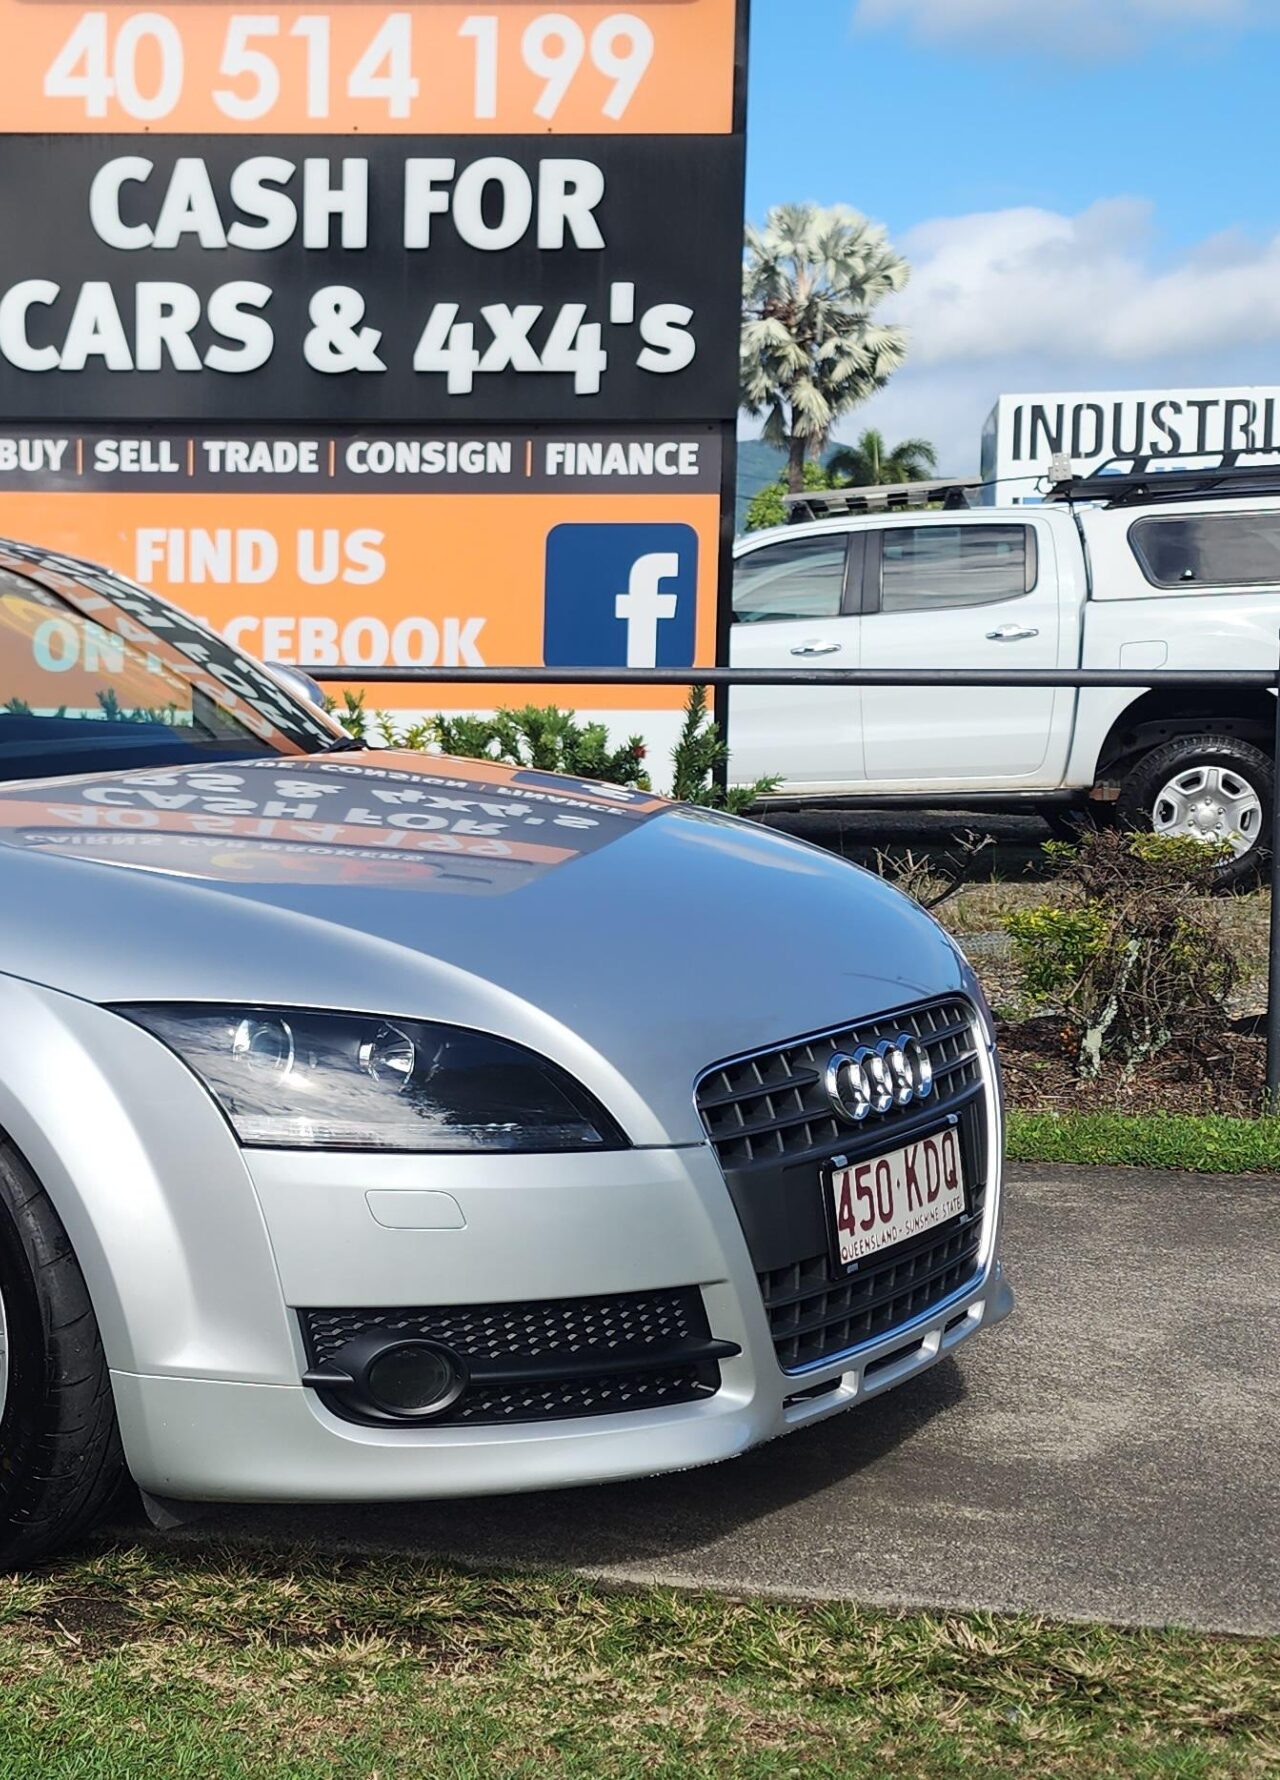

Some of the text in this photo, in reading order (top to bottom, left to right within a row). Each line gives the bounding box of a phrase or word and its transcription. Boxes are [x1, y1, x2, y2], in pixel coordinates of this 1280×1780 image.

[44, 13, 654, 121] 40 514 199
[89, 156, 606, 251] CASH FOR
[304, 285, 387, 374] &
[94, 439, 179, 473] SELL
[203, 440, 319, 474] TRADE
[345, 440, 512, 475] CONSIGN
[545, 441, 700, 476] FINANCE
[1012, 398, 1280, 460] INDUSTRI
[134, 527, 385, 586] FIND US
[32, 616, 488, 673] ON CEBOOK
[841, 1226, 897, 1260] QUEENSLAND
[905, 1207, 939, 1235] SUNSHINE
[943, 1196, 961, 1219] STATE
